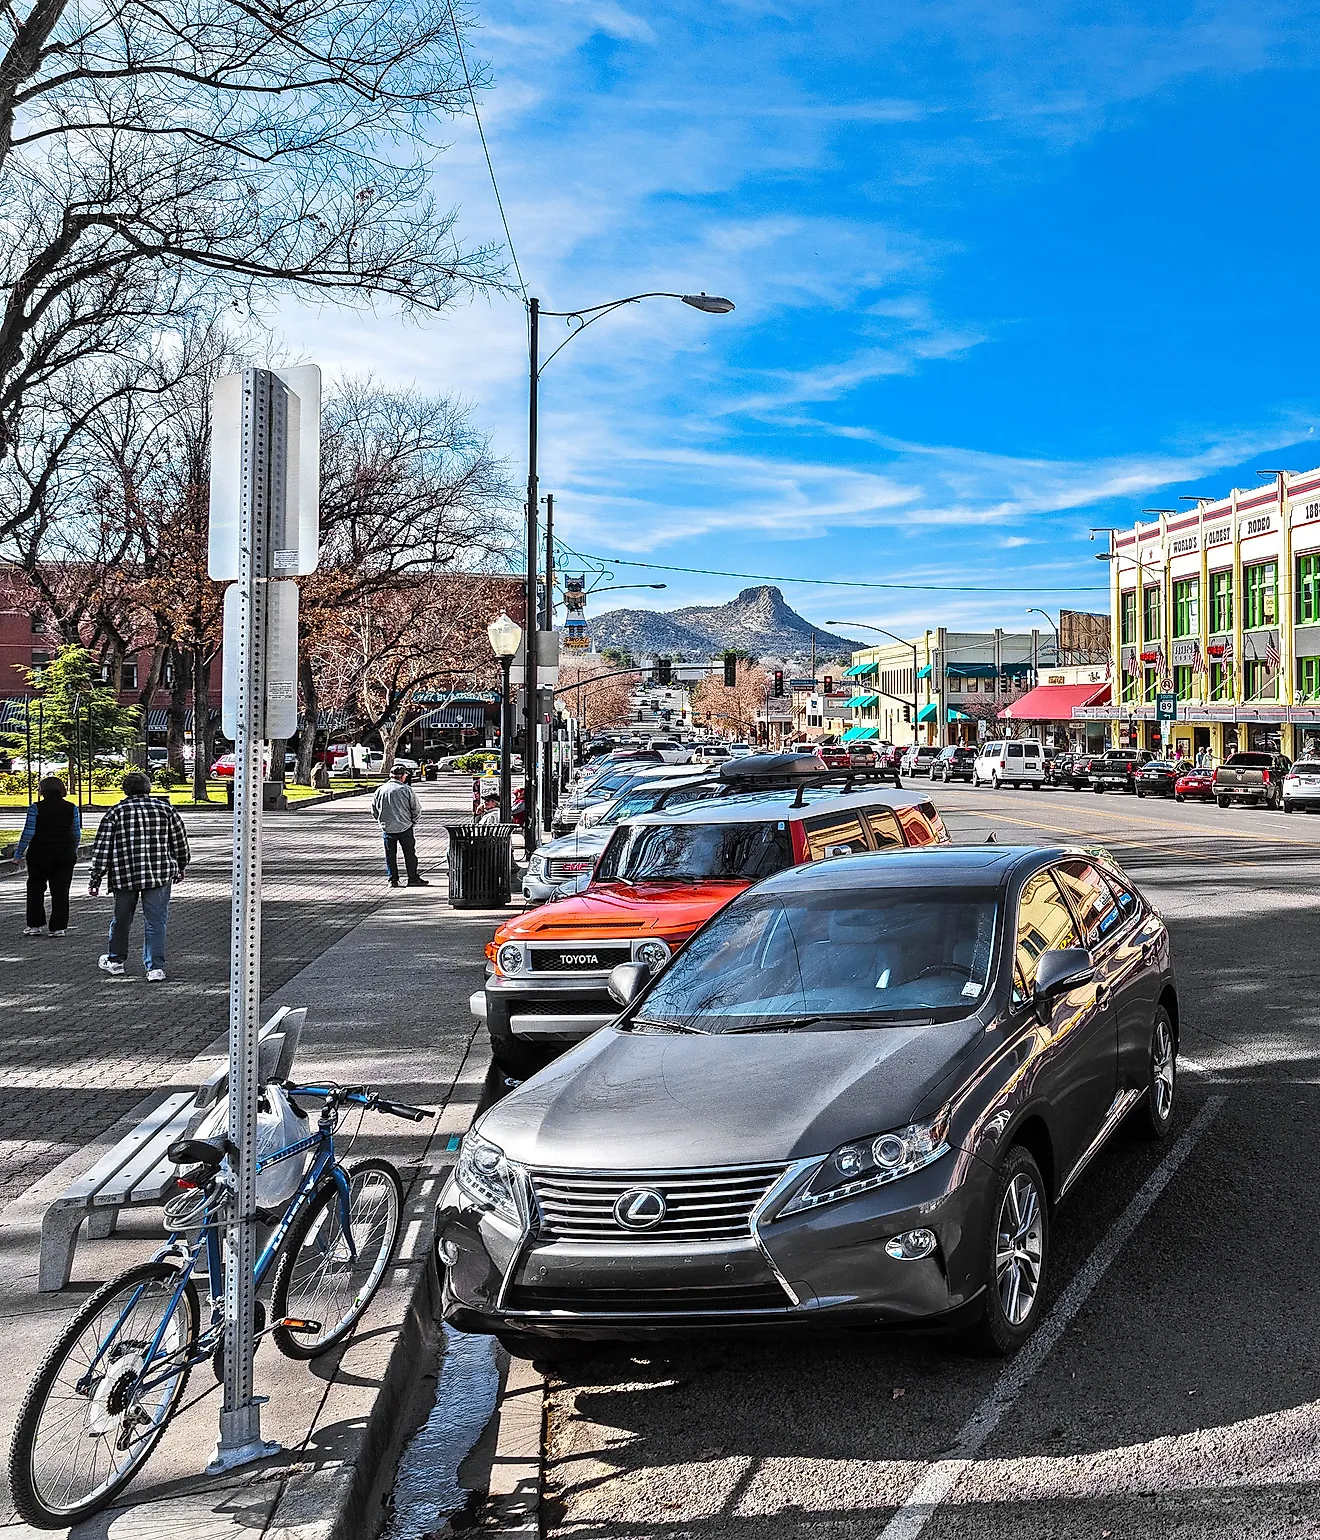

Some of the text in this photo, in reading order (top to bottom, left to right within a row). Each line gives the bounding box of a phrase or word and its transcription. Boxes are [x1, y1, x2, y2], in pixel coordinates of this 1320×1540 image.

[1173, 536, 1198, 553] WORLD'S
[1208, 527, 1231, 545] OLDEST
[1247, 516, 1271, 534] RODEO
[1161, 702, 1172, 711] 89
[562, 863, 589, 871] GMC
[559, 954, 599, 964] TOYOTA
